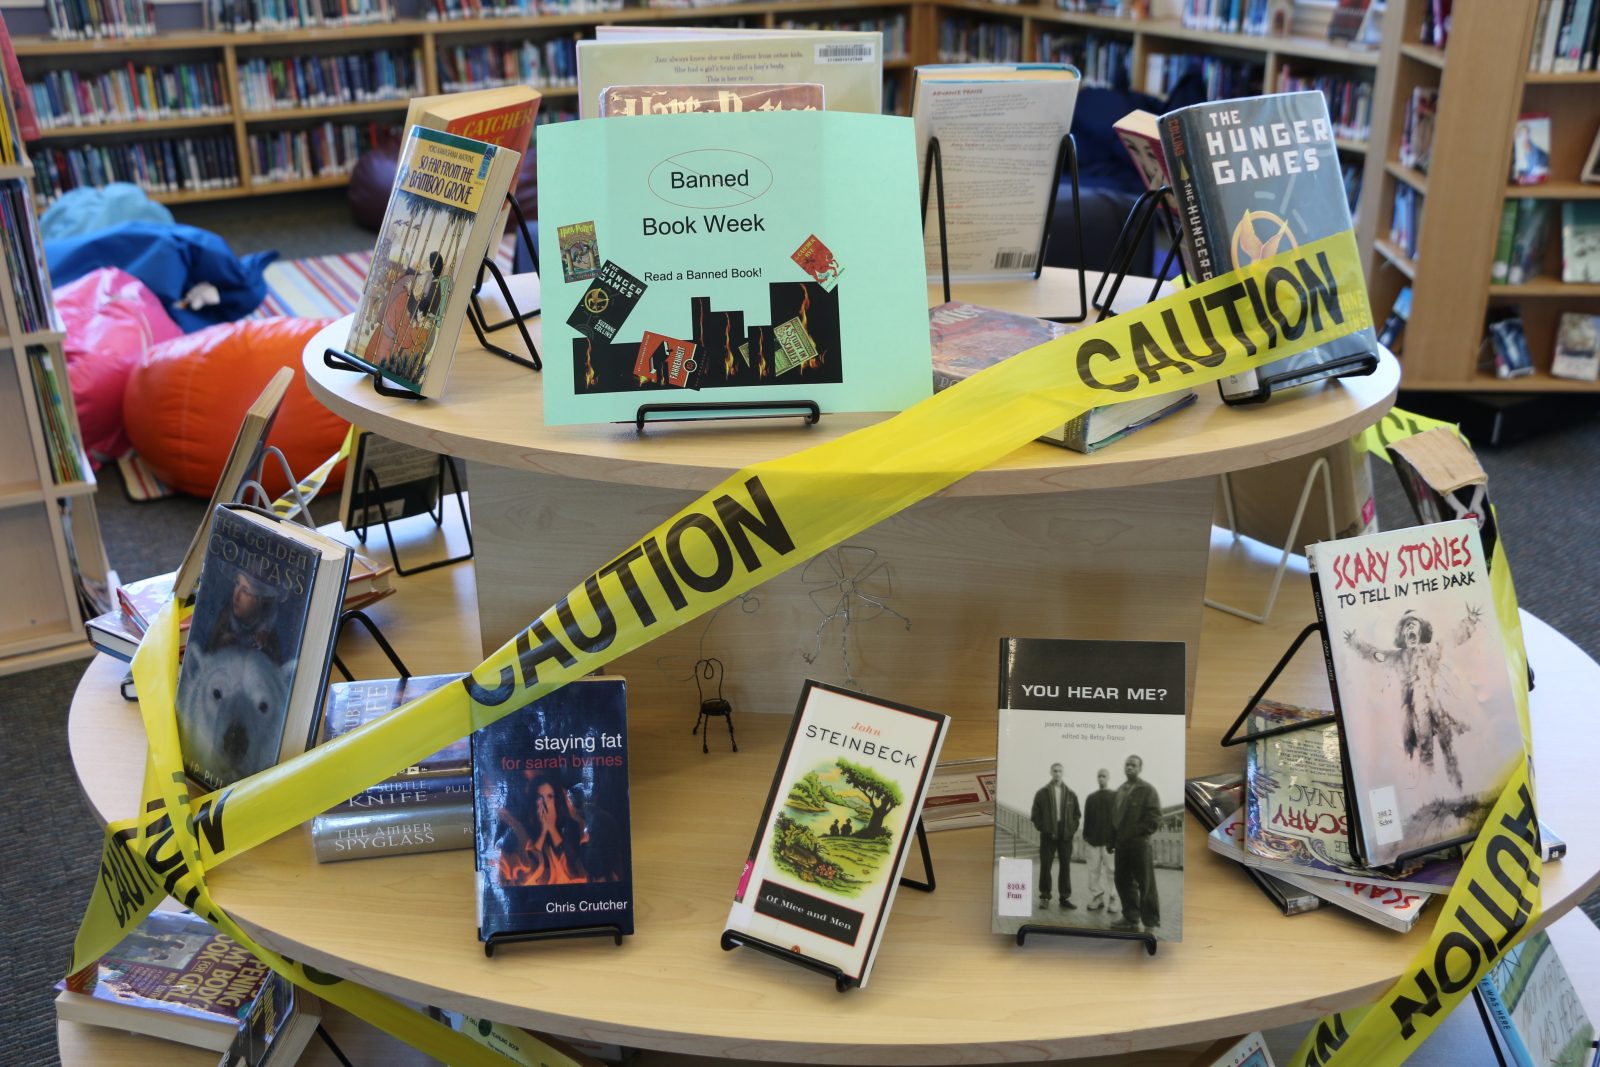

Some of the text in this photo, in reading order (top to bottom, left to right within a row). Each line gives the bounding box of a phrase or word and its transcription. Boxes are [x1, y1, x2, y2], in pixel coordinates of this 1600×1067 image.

[463, 107, 532, 137] CATCHER
[1209, 110, 1242, 127] THE
[1205, 118, 1330, 156] HUNGER
[419, 155, 429, 170] SO
[428, 157, 442, 174] FAR
[440, 161, 462, 179] FROM
[460, 166, 475, 183] THE
[670, 169, 749, 189] Banned
[1212, 147, 1321, 186] GAMES
[409, 171, 474, 205] BAMBOO GROVE
[642, 214, 766, 236] Book Week
[1188, 205, 1212, 272] HUNGER
[599, 273, 634, 299] GAMES
[602, 266, 643, 296] HUNGER
[644, 267, 762, 282] Read a Banned Book!
[1076, 251, 1344, 393] CAUTION
[215, 514, 308, 570] THE GOLDEN
[208, 533, 306, 597] COMPASS
[1333, 534, 1472, 590] SCARY STORIES
[463, 476, 796, 707] CAUTION
[1337, 571, 1476, 609] TO TELL IN THE DARK
[1021, 684, 1168, 702] YOU HEAR ME?
[851, 721, 881, 738] John
[1076, 722, 1095, 730] writing
[1106, 723, 1128, 731] teenage
[534, 733, 622, 754] staying fat
[805, 724, 919, 770] STEINBECK
[502, 754, 623, 771] for sarah byrnes
[349, 791, 428, 807] KNIFE
[377, 780, 428, 792] SUBTLE
[335, 833, 435, 851] SPYGLASS
[336, 822, 433, 840] THE AMBER
[546, 899, 628, 913] Chris Crutcher
[766, 893, 852, 930] Of Mice and Men
[1390, 783, 1541, 1041] AUTION
[1486, 990, 1511, 1030] WAS HERE
